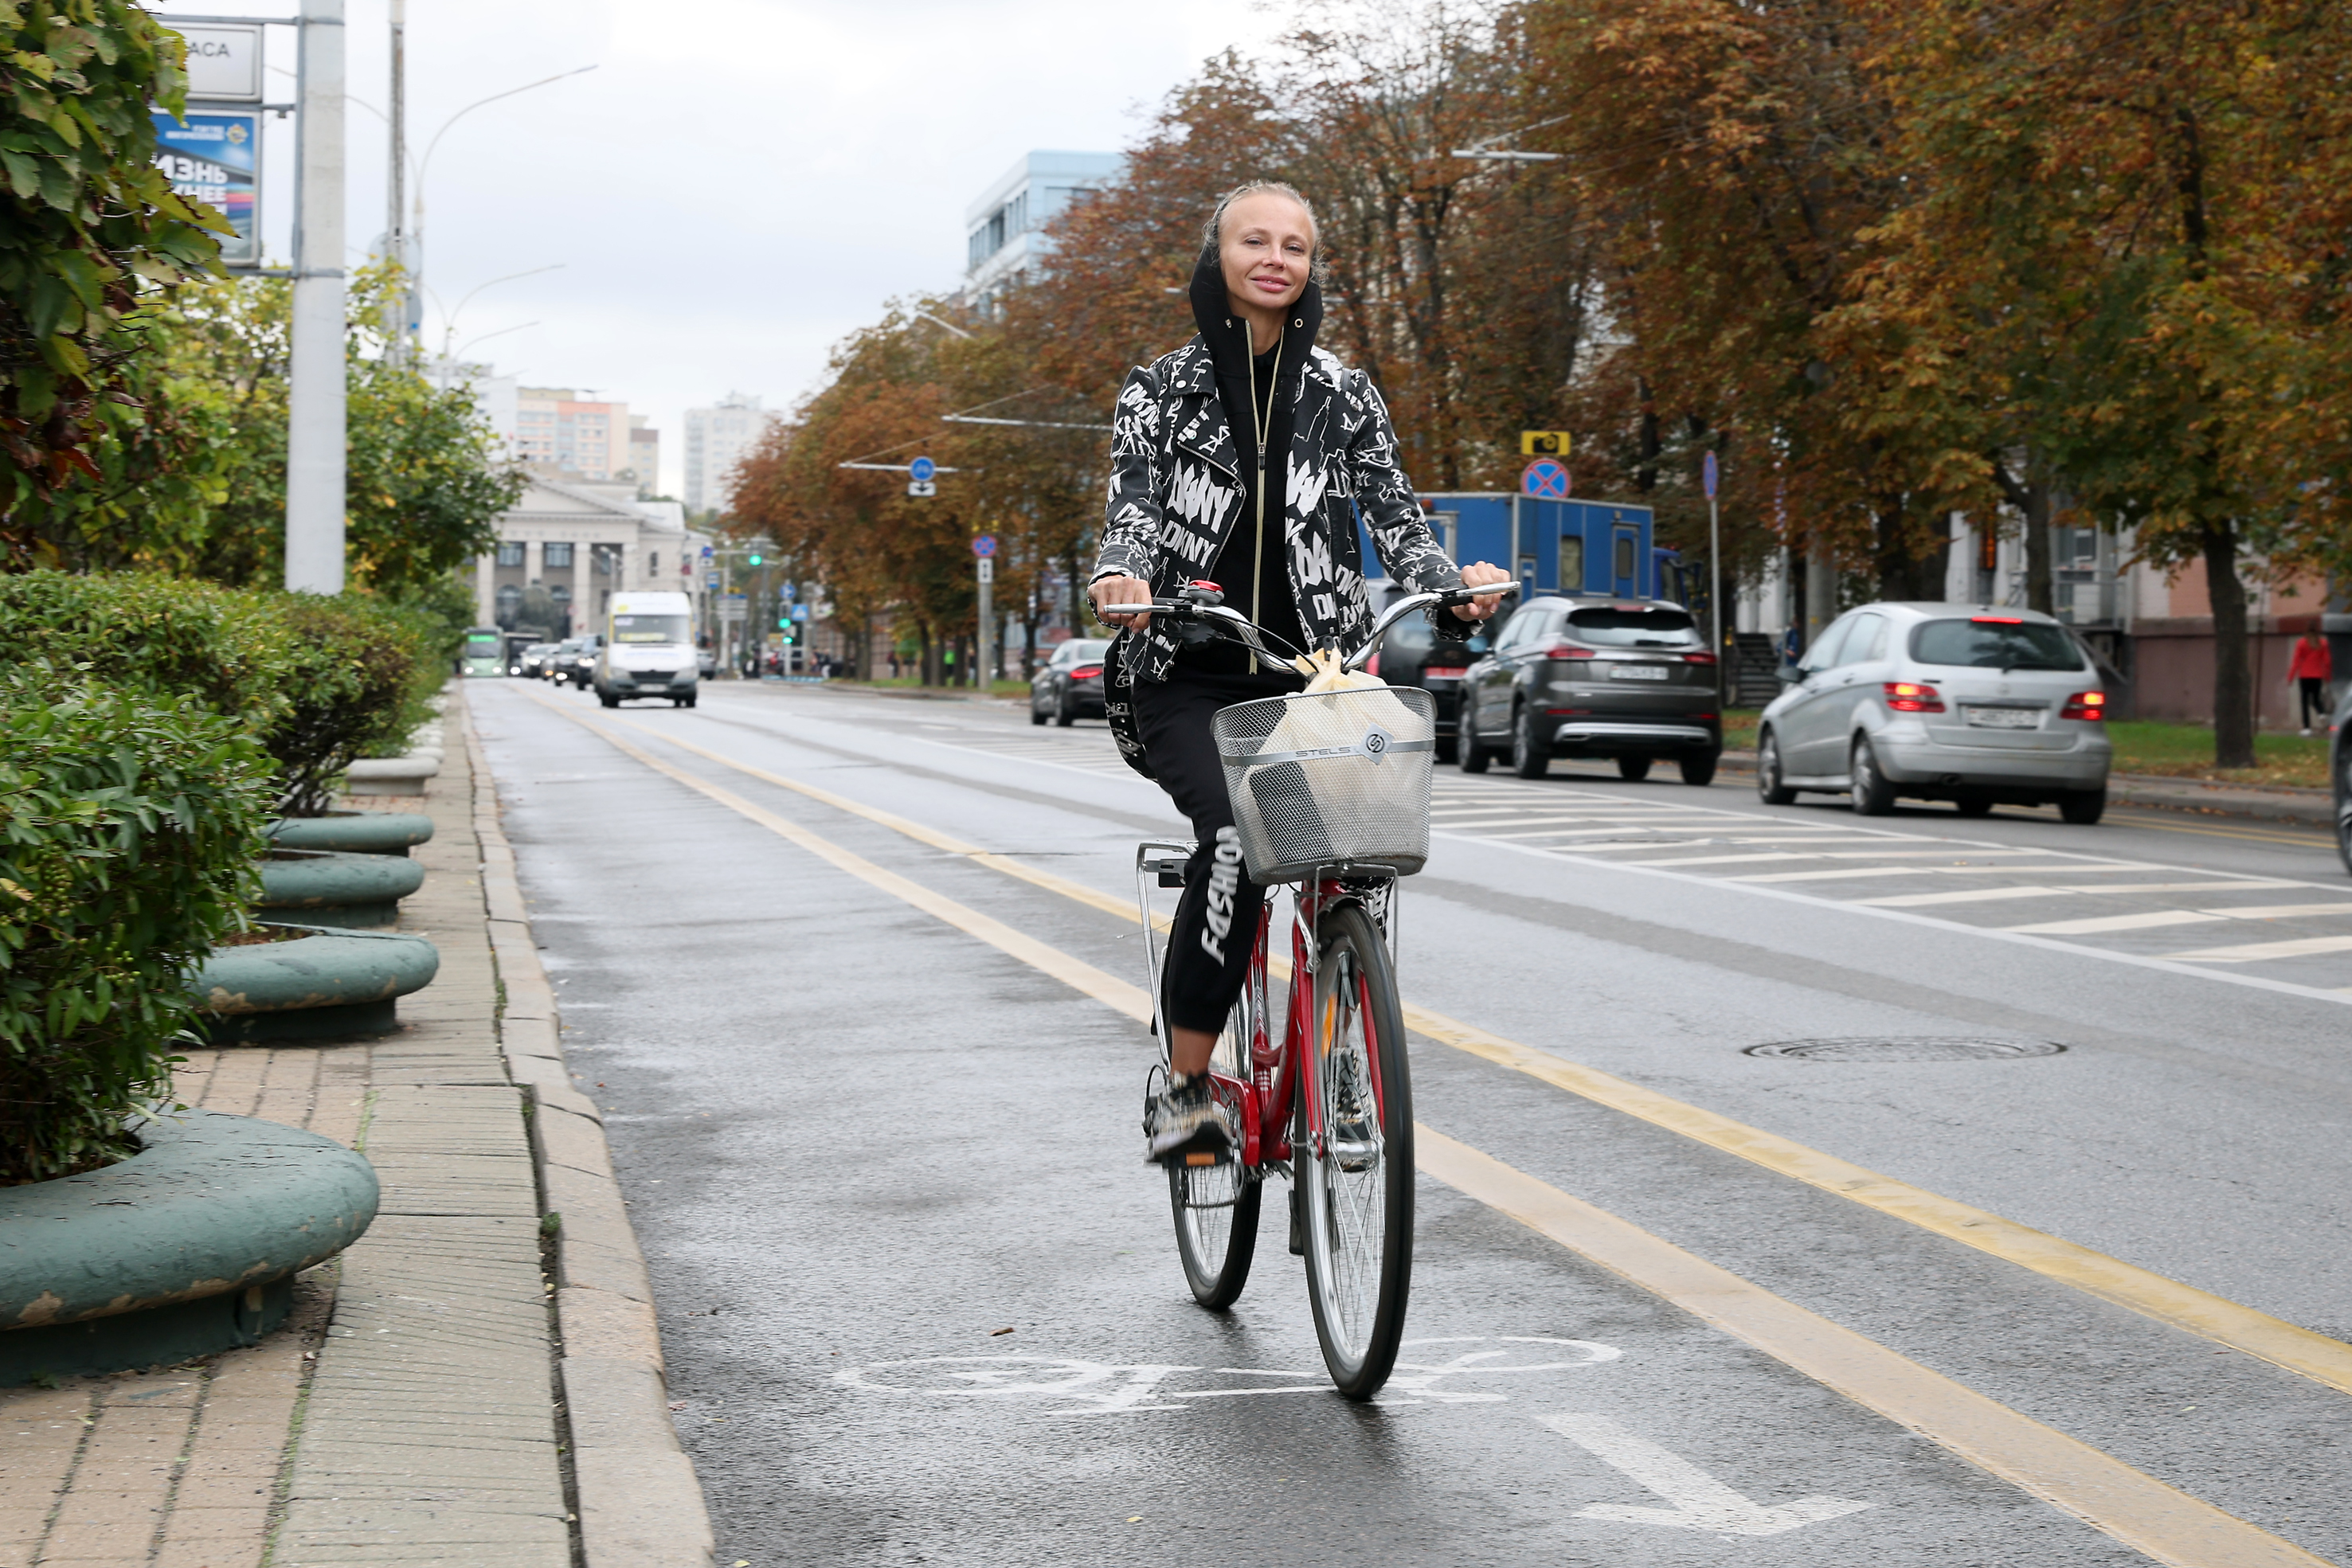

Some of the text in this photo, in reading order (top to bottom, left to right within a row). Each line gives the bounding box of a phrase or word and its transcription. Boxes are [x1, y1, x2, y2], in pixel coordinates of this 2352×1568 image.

[150, 154, 228, 184] ИЗНЬ
[1165, 456, 1235, 534] DKNY
[1159, 519, 1218, 570] DKNY
[1295, 746, 1351, 758] STELS
